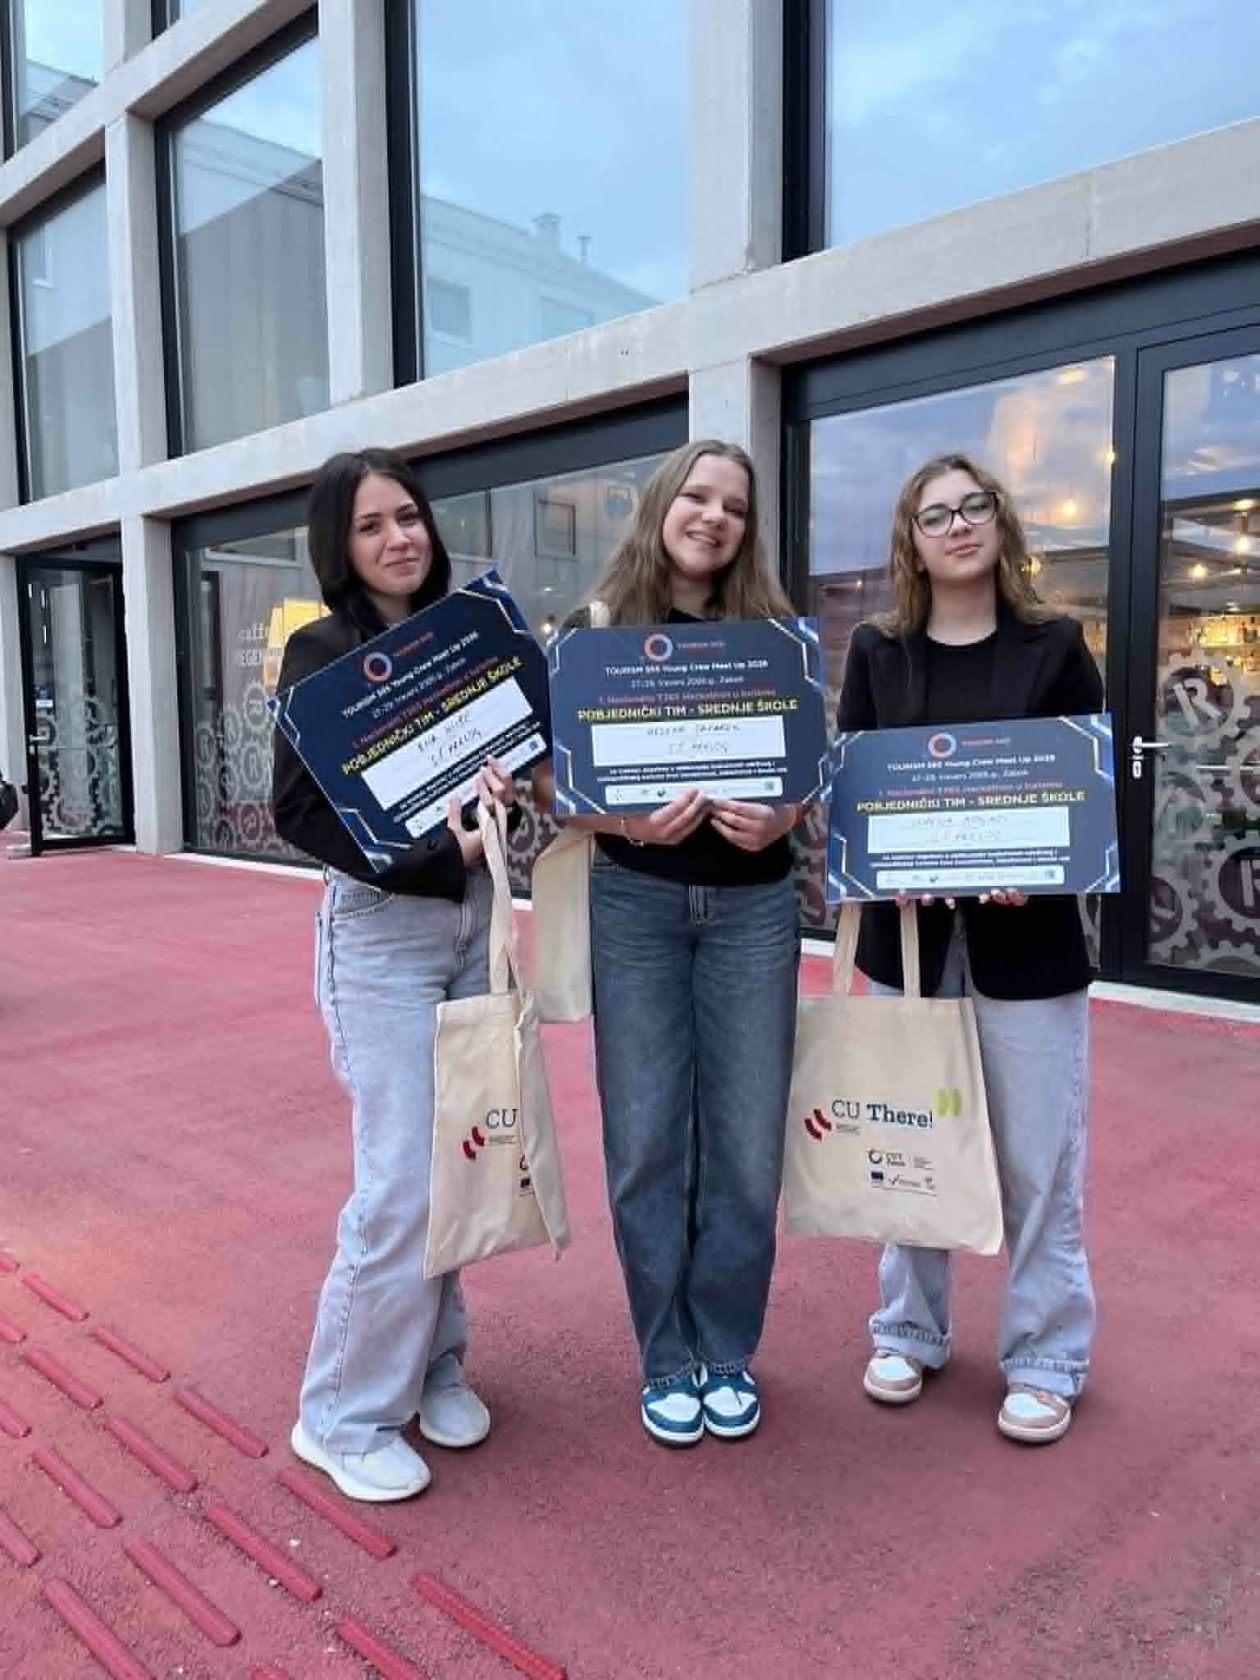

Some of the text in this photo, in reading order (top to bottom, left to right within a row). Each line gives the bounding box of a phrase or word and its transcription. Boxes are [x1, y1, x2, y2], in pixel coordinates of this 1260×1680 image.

[577, 704, 661, 721] POBJEDNIČKI
[664, 705, 686, 717] TIM
[698, 701, 753, 716] SREDNJE
[757, 697, 798, 712] ŠKOLE
[857, 797, 940, 812] POBJEDNIČKI
[944, 797, 966, 809] TIM
[978, 793, 1037, 807] SREDNJE
[1041, 790, 1086, 803] ŠKOLE
[486, 1108, 518, 1129] CU
[832, 1099, 933, 1128] CU There!
